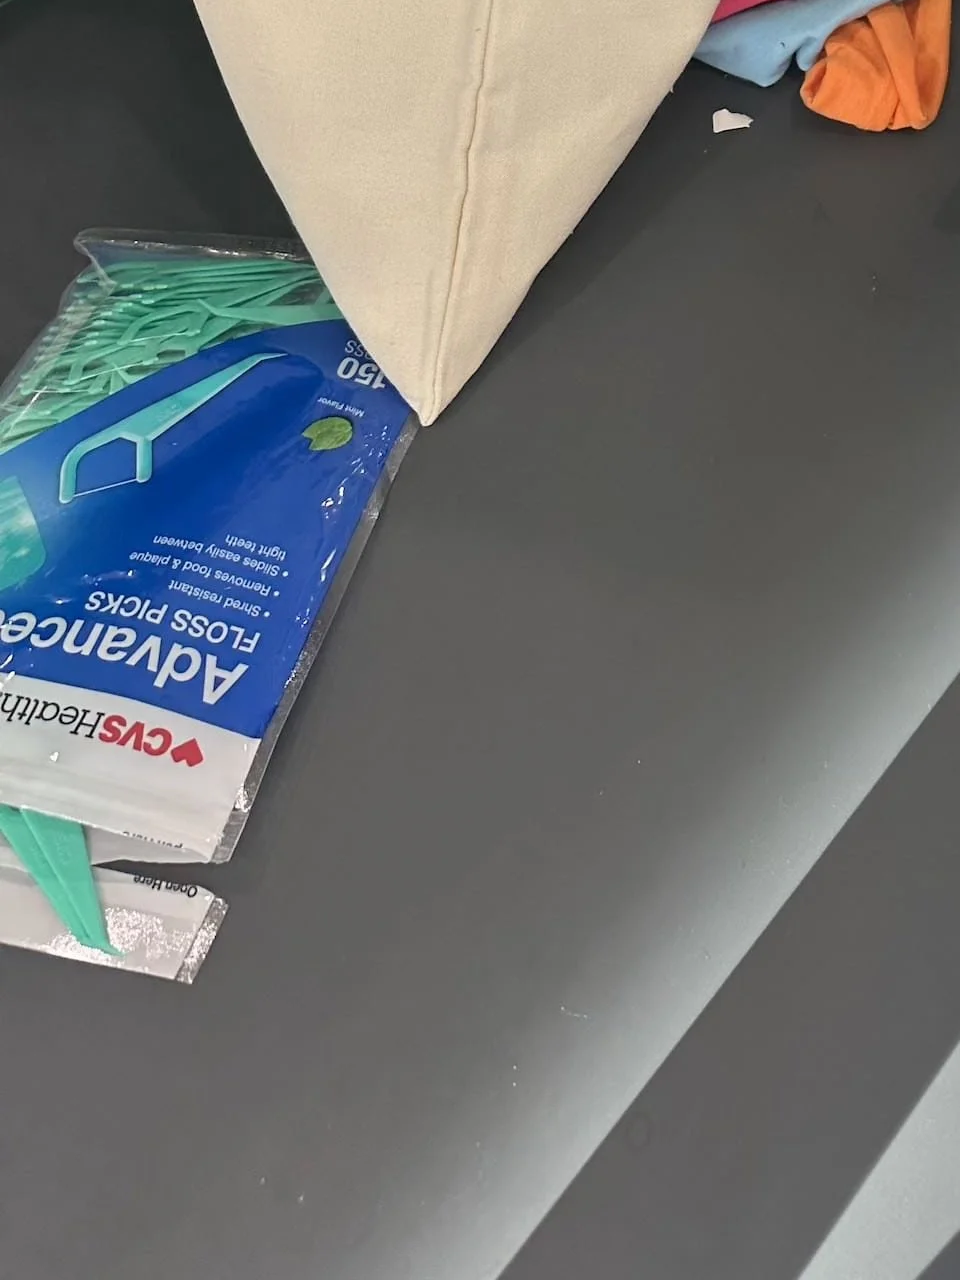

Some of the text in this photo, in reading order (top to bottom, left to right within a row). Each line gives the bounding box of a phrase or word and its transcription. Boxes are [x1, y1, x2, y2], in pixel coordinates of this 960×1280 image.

[335, 354, 389, 390] 150
[316, 394, 364, 418] Mint Flavor
[152, 533, 280, 576] Slides easily between
[224, 533, 286, 561] tight teeth
[128, 549, 271, 596] Removes food & plaque
[167, 578, 261, 617] Shred resistant
[83, 583, 261, 654] FLOSS PICKS
[0, 597, 250, 711] Advance
